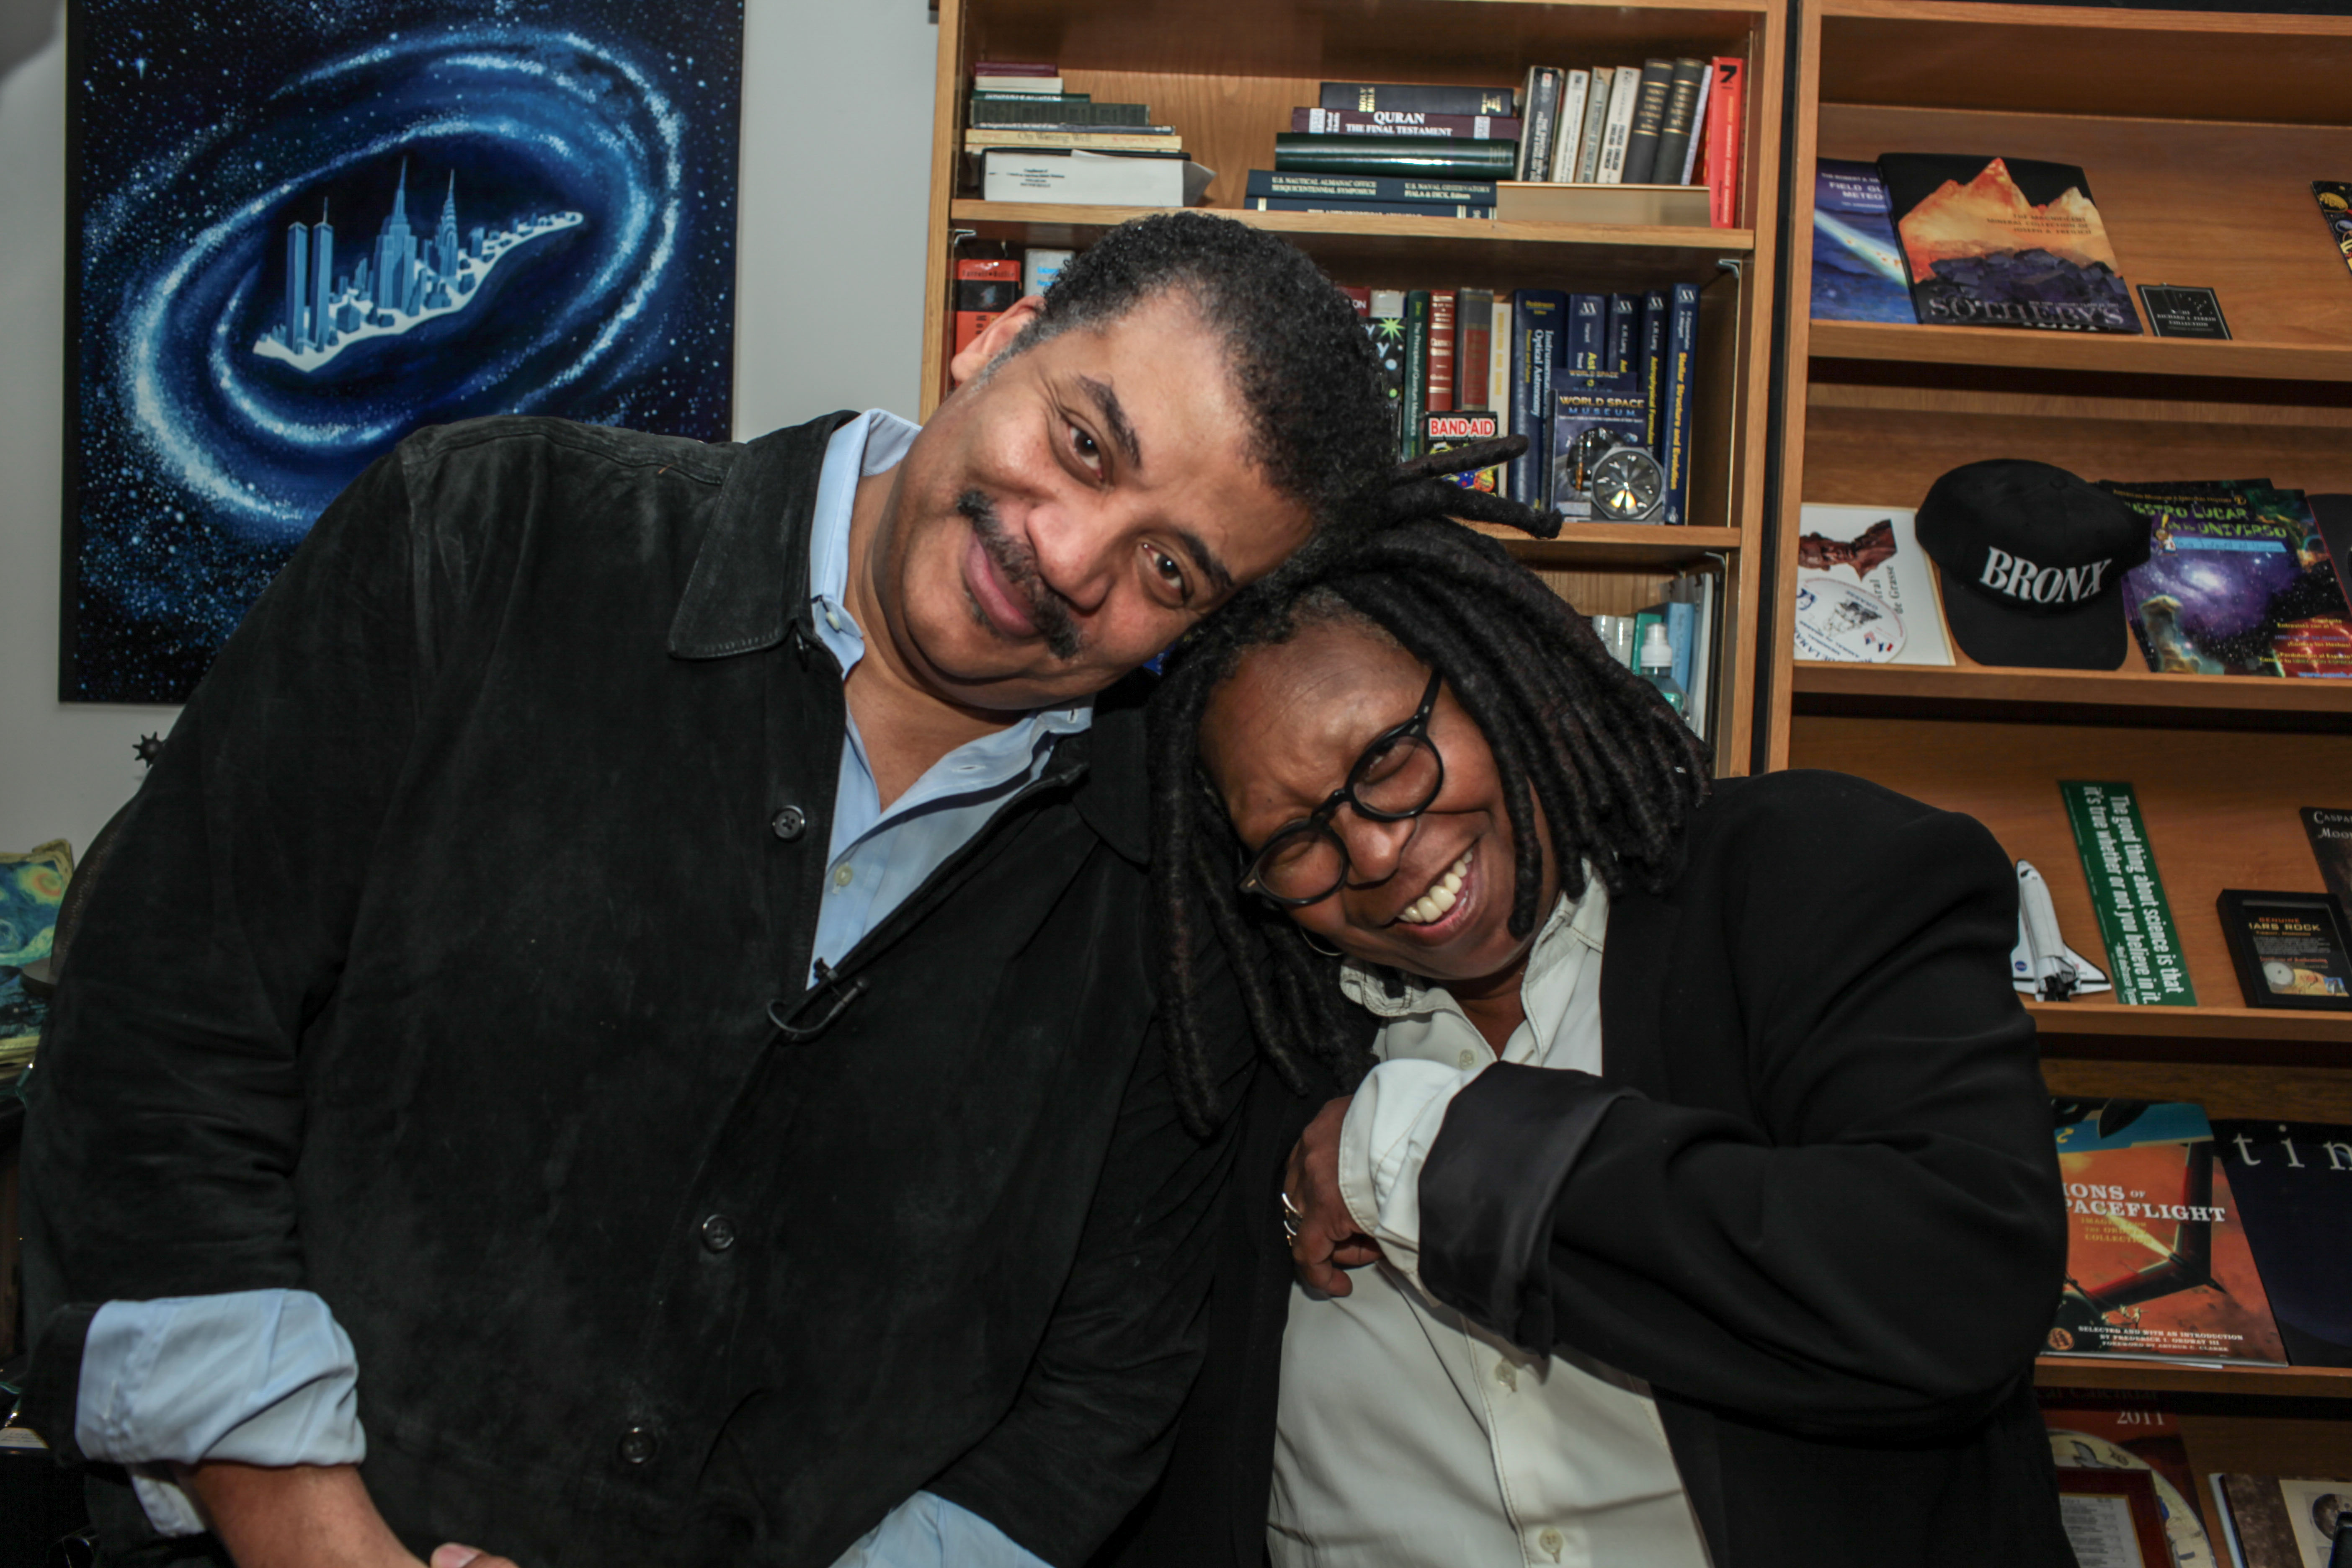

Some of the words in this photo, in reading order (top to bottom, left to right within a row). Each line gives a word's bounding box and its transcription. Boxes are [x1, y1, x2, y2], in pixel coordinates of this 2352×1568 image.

[1374, 111, 1425, 125] QURAN
[1345, 124, 1365, 133] THE
[1366, 124, 1395, 134] FINAL
[1396, 126, 1453, 136] TESTAMENT
[1336, 187, 1376, 196] SYMPOSIUM
[1442, 184, 1491, 193] OBSERVATORY
[1829, 181, 1862, 191] FIELD
[1929, 297, 2124, 325] SOTHEBY'S
[1412, 335, 1421, 366] Principles
[1532, 329, 1544, 364] Optical
[1677, 353, 1687, 383] Stellar
[1411, 372, 1420, 400] Quantum
[1530, 366, 1543, 417] Astronomy
[1559, 396, 1604, 406] WORLD
[1607, 397, 1645, 409] SPACE
[1568, 407, 1636, 417] MUSEUM
[1675, 384, 1685, 427] Structure
[1409, 402, 1419, 436] Mechanics
[1429, 419, 1495, 436] BAND-AID
[1673, 428, 1681, 446] and
[1670, 447, 1681, 490] Evolution
[2198, 522, 2287, 538] UNIVERSO
[1886, 565, 1900, 599] Grasse
[1980, 546, 2112, 604] BRONX
[2110, 795, 2130, 815] The
[2089, 806, 2108, 829] true
[2313, 811, 2352, 824] CASPA
[2111, 815, 2141, 842] good
[2096, 830, 2122, 875] whether
[2125, 844, 2147, 873] thing
[2109, 877, 2126, 889] or
[2133, 875, 2159, 907] about
[2113, 890, 2135, 910] not
[2113, 910, 2138, 932] you
[2143, 908, 2167, 952] science
[2125, 933, 2150, 975] believe
[2155, 954, 2177, 965] is
[2137, 977, 2157, 989] in
[2160, 967, 2184, 993] that
[2141, 991, 2161, 1004] it.
[2130, 1190, 2146, 1199] OF
[2078, 1325, 2121, 1335] SELECTED
[2179, 1331, 2244, 1341] INTRODUCTION
[2112, 1334, 2162, 1343] FREDERICK
[2117, 1408, 2165, 1425] 2011
